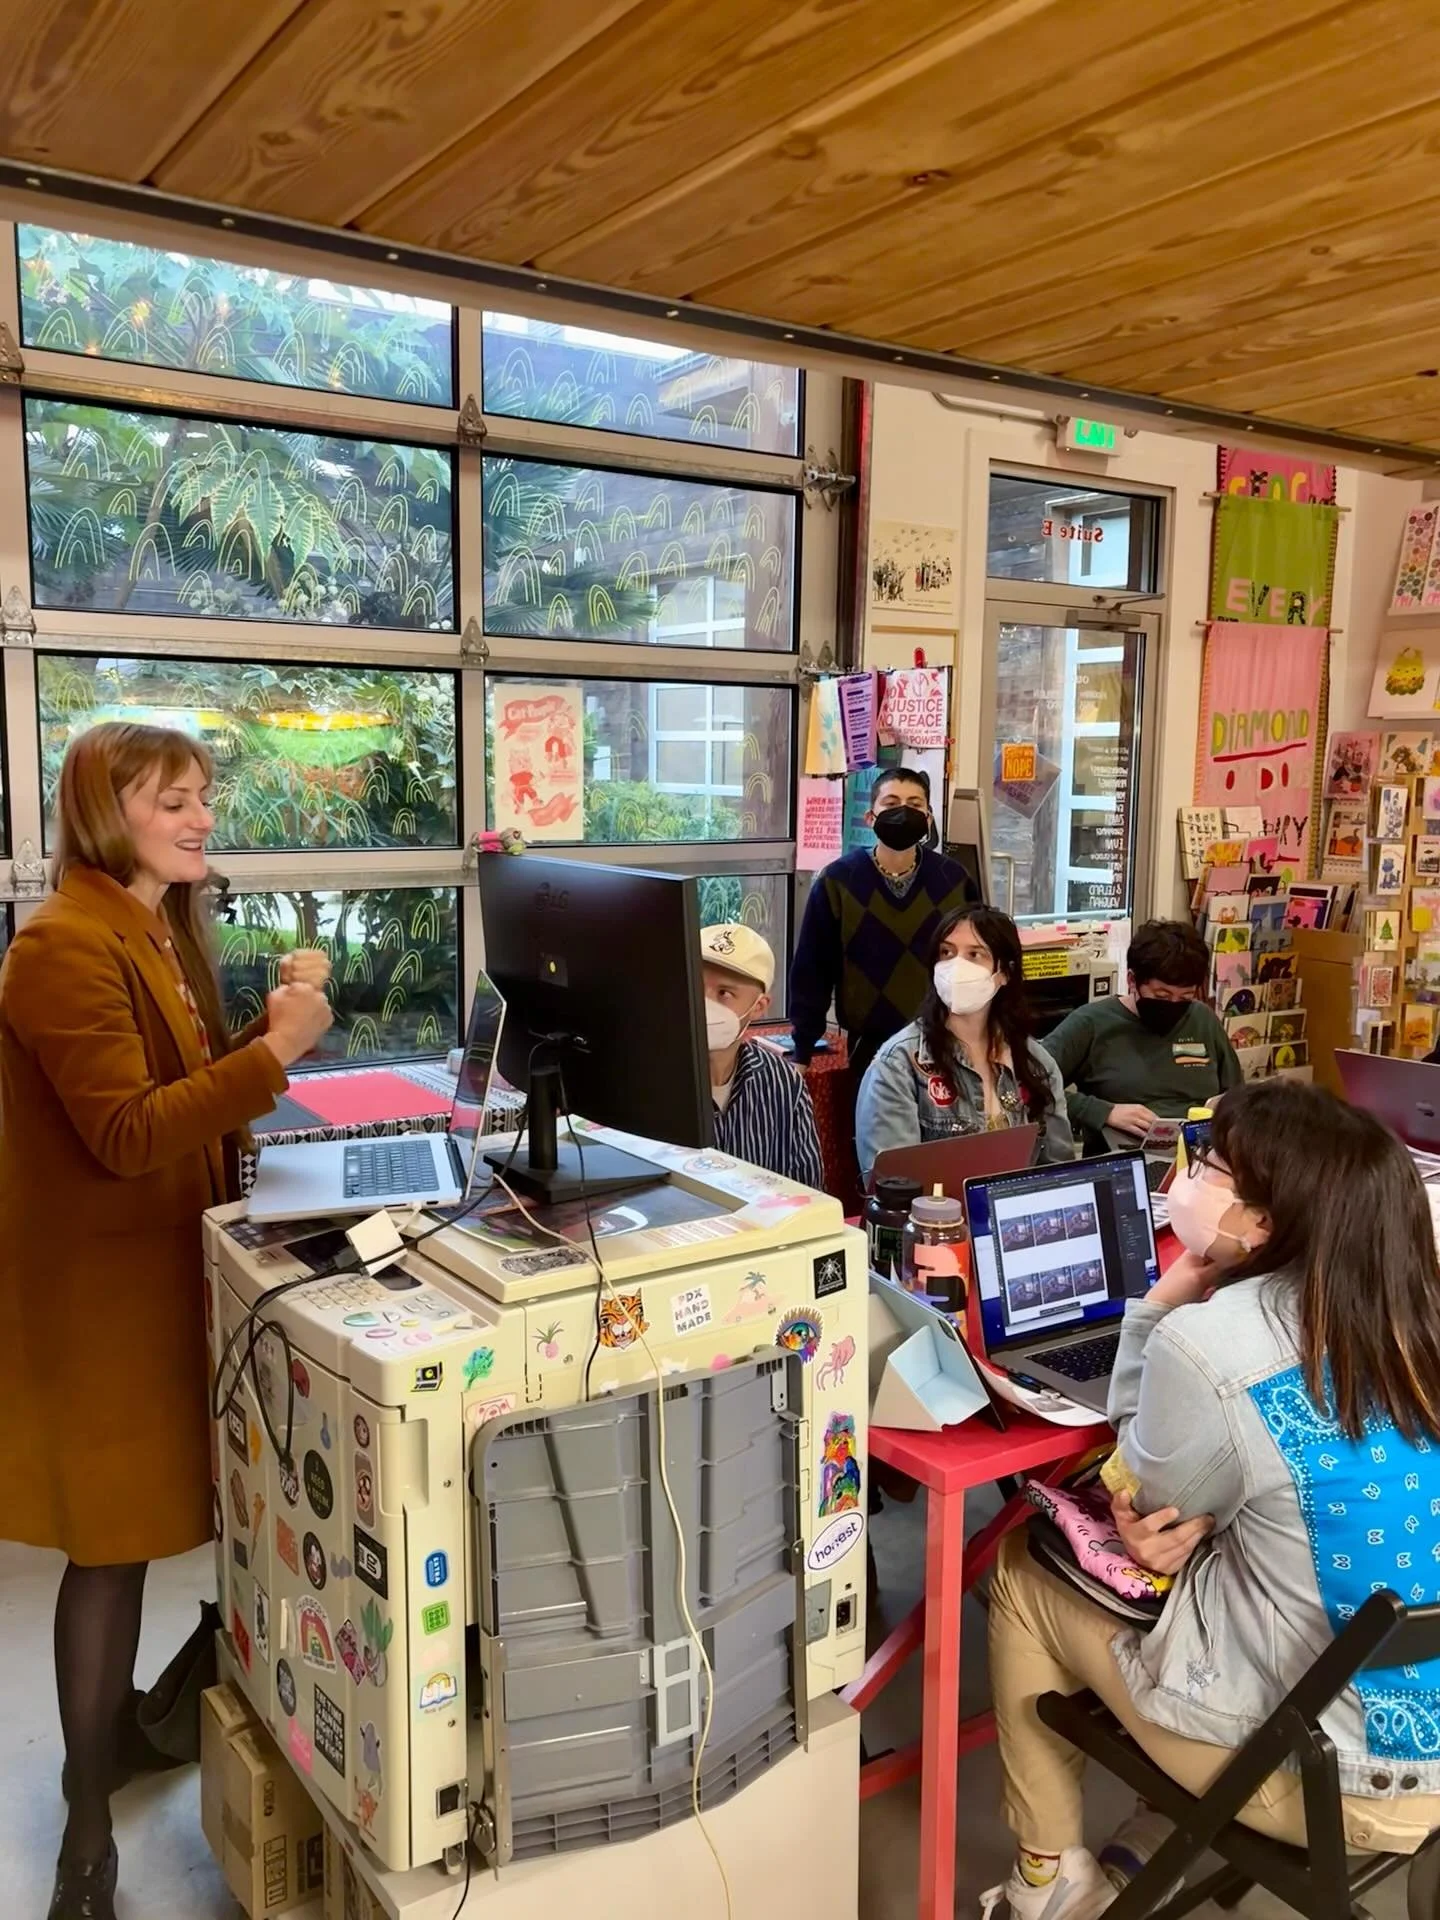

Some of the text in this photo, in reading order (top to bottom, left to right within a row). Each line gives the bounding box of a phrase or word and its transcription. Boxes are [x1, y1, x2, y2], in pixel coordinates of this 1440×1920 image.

[1226, 577, 1328, 627] EVERY
[899, 714, 942, 727] PEACE
[1006, 758, 1033, 777] NOPE
[678, 1288, 703, 1304] PDX
[675, 1300, 709, 1320] HAND
[677, 1312, 712, 1333] MADE
[815, 1522, 857, 1562] honest
